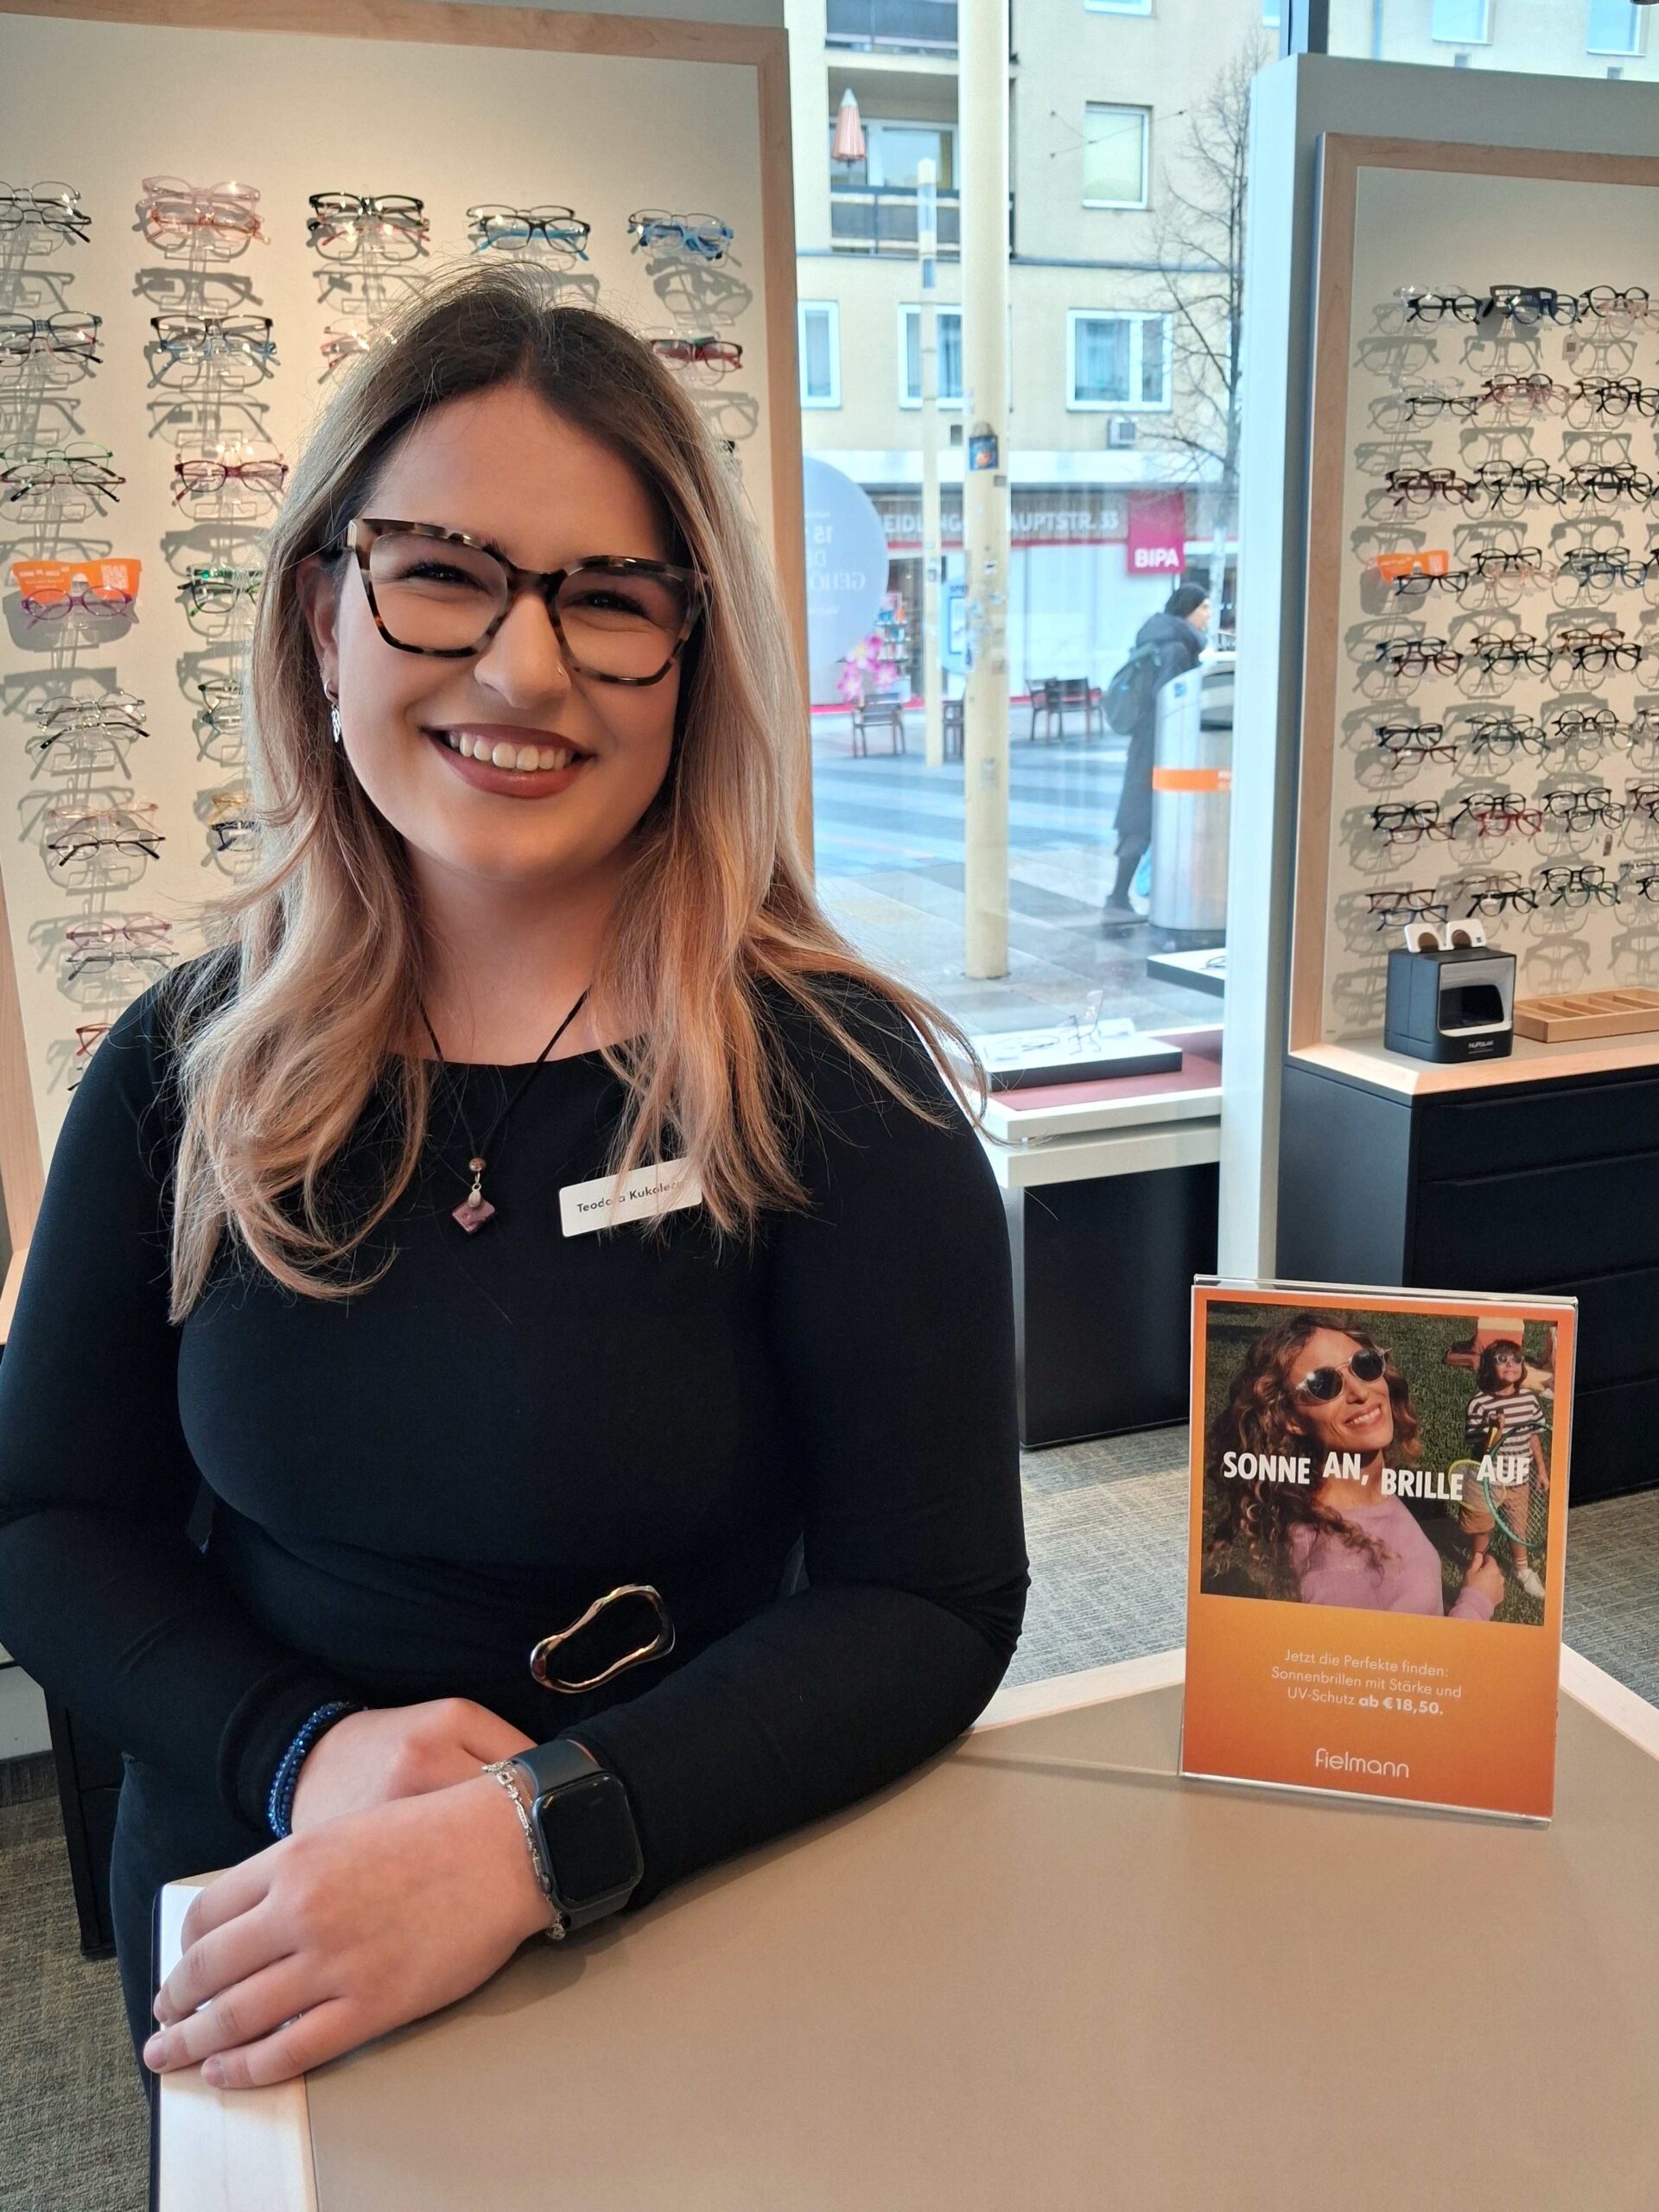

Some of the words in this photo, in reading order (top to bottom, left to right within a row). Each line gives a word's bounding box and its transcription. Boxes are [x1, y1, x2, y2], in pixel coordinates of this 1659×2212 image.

[1135, 548, 1180, 569] BIPA
[1223, 1451, 1311, 1484] SONNE
[1323, 1452, 1370, 1485] AN,
[1381, 1469, 1464, 1501] BRILLE
[1476, 1454, 1531, 1485] AUF
[1284, 1649, 1315, 1662] Jetzt
[1319, 1651, 1340, 1666] die
[1344, 1655, 1398, 1672] Perfekte
[1402, 1661, 1449, 1677] finden:
[1271, 1666, 1362, 1688] Sonnenbrillen
[1365, 1677, 1386, 1690] mit
[1389, 1678, 1432, 1695] Stärke
[1436, 1685, 1462, 1699] und
[1287, 1687, 1355, 1706] UV-Schutz
[1358, 1694, 1379, 1708] ab
[1314, 1747, 1410, 1778] fielmann
